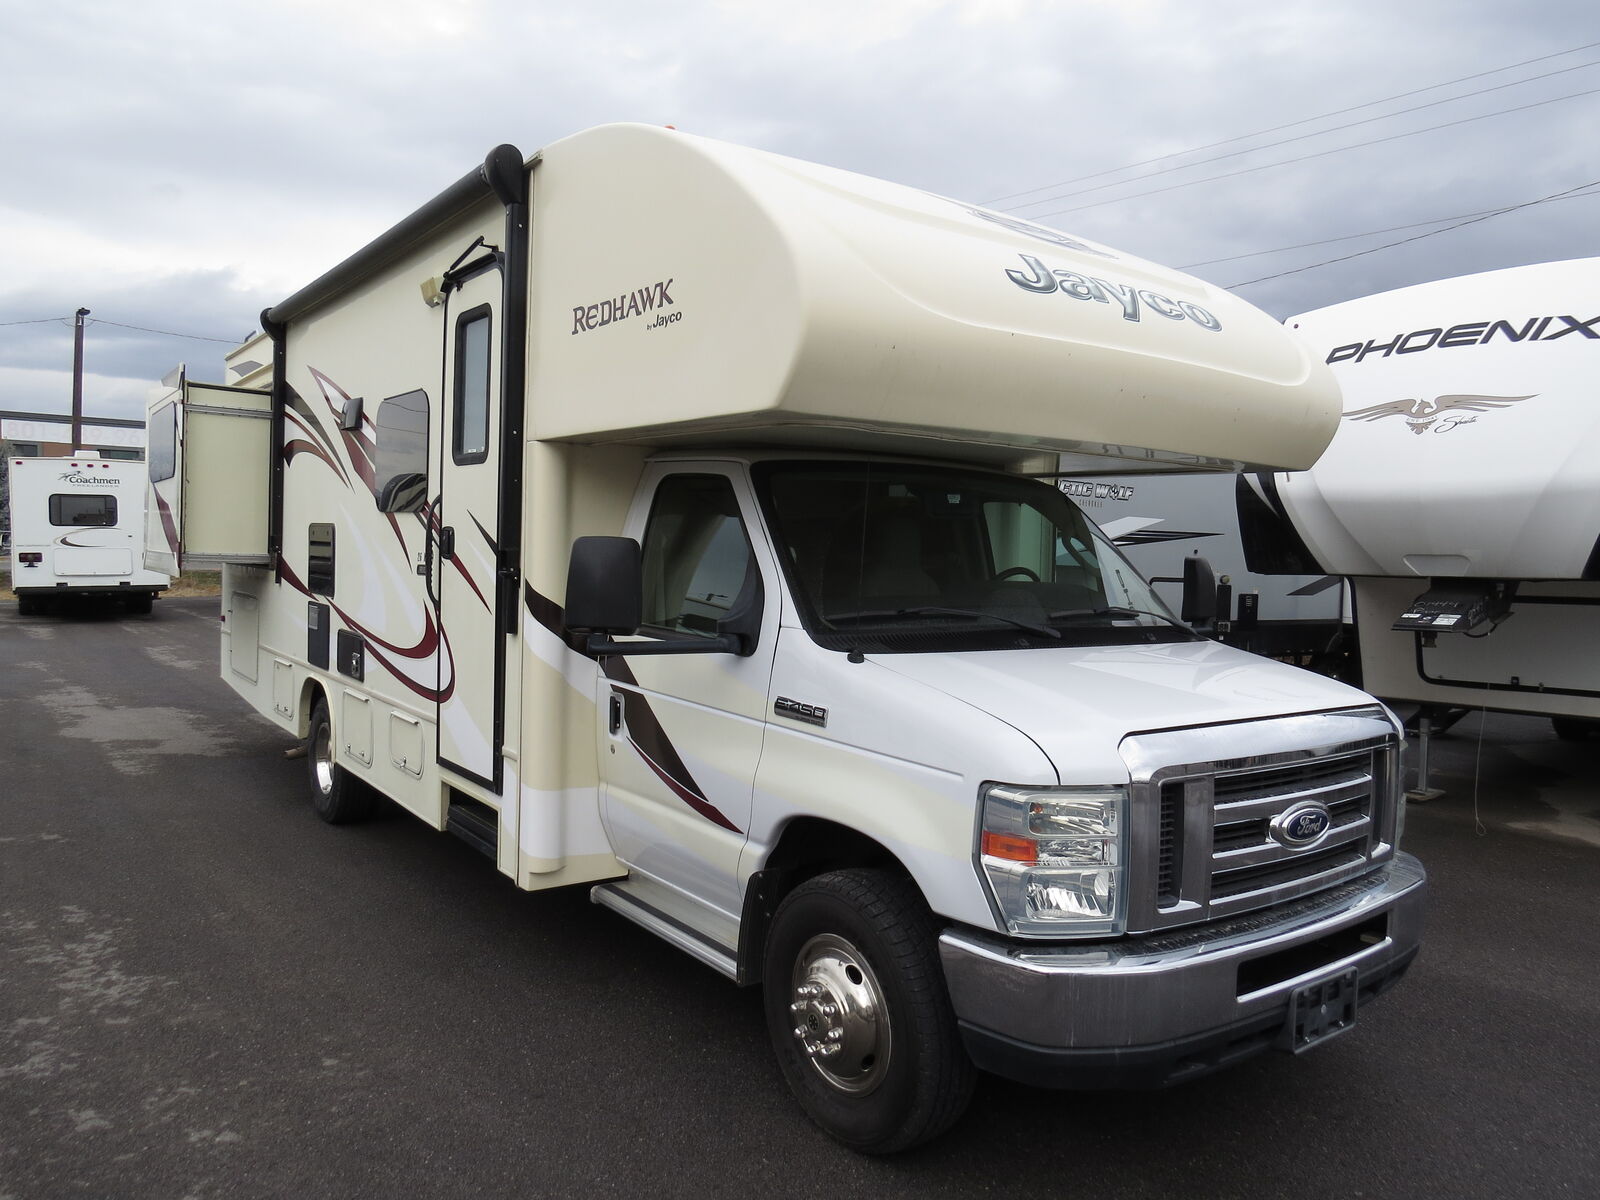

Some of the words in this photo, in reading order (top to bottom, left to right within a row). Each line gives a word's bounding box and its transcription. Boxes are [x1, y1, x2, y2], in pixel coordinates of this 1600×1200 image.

[1005, 253, 1223, 332] Jayco
[571, 278, 674, 335] REDHAWK
[653, 311, 682, 328] Jayco
[1325, 315, 1600, 365] PHOENIX
[69, 476, 120, 485] Coachmen
[1057, 479, 1093, 497] CTIC
[1297, 814, 1323, 836] Ford
